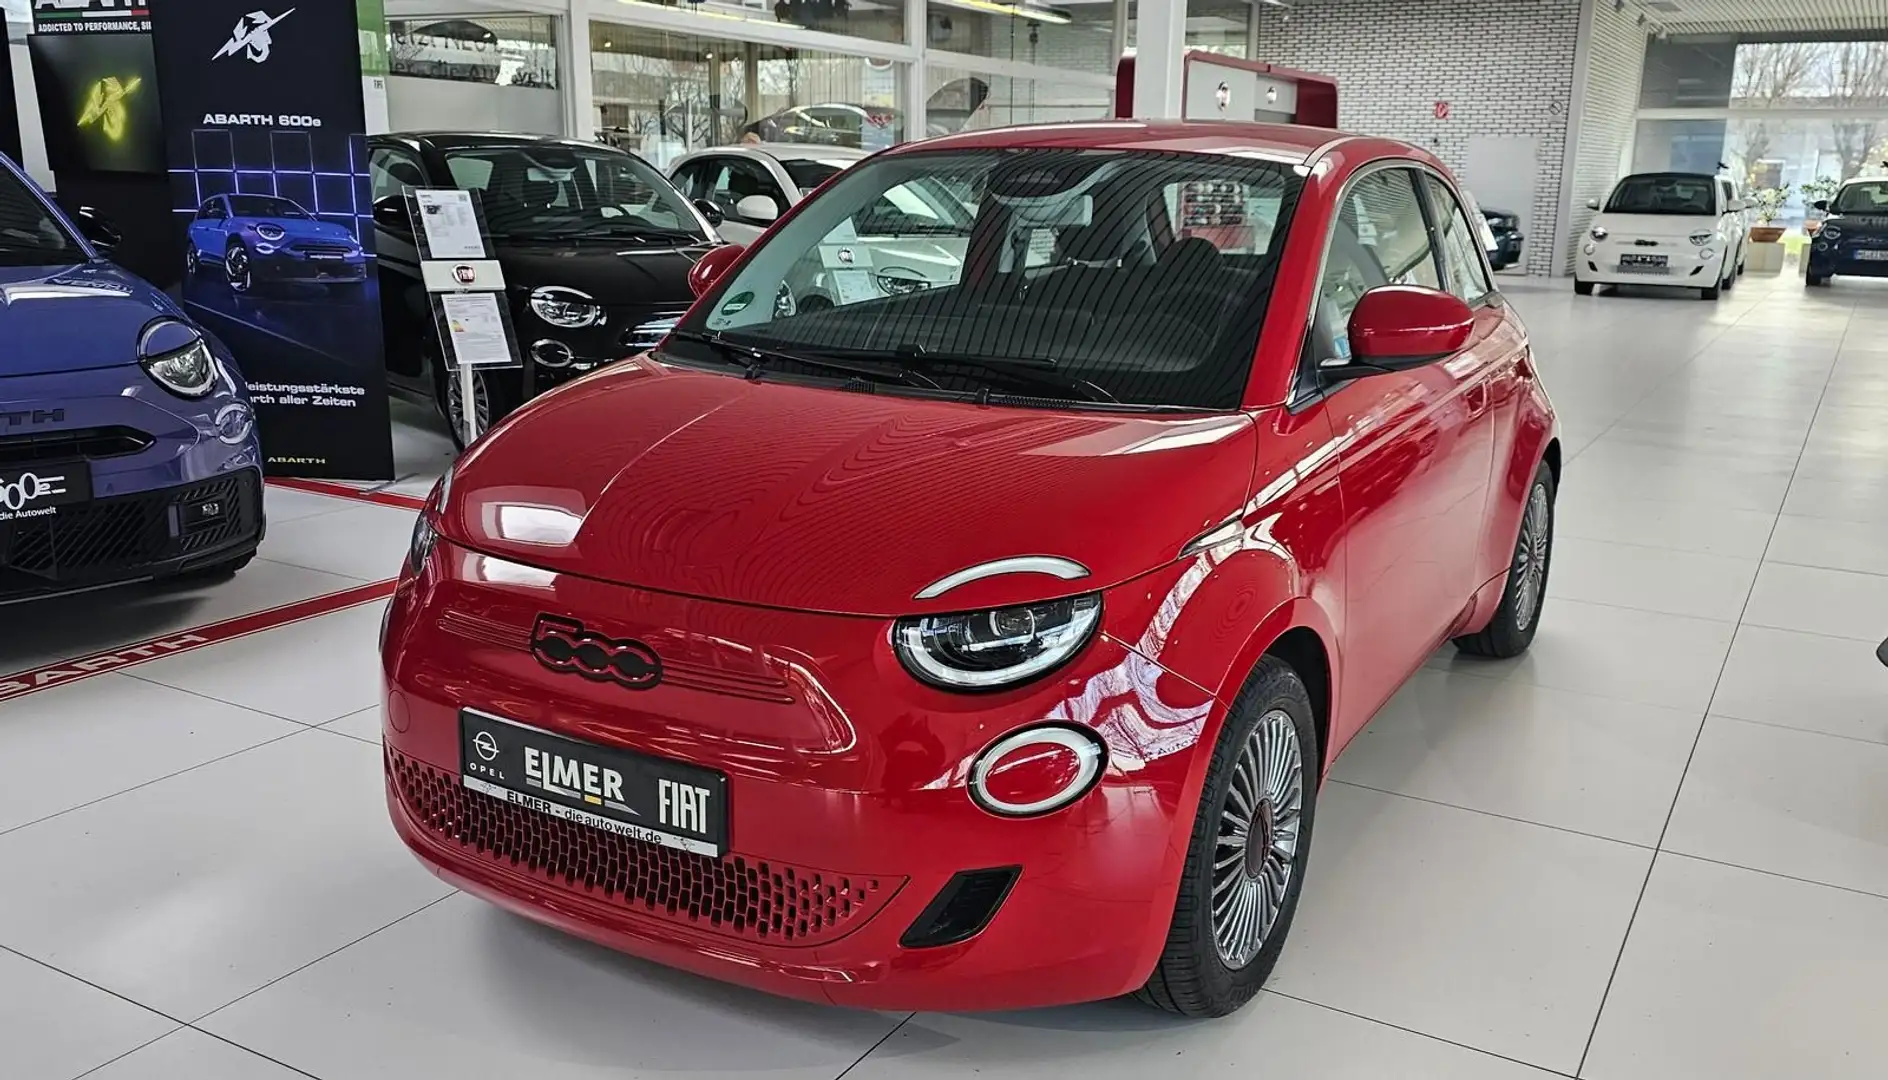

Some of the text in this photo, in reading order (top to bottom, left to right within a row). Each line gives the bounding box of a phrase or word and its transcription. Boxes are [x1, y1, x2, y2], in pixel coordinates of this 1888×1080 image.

[38, 22, 72, 32] ADDICTED
[73, 22, 84, 31] TO
[85, 21, 140, 32] PERFORMANCE,
[203, 113, 321, 127] ABARTH 600e
[250, 395, 356, 407] rth aller Zeiten
[267, 456, 326, 464] ABARTH
[15, 505, 57, 518] Autowelt
[529, 611, 663, 691] 500
[469, 761, 505, 780] OPEL
[524, 746, 626, 803] ELMER
[506, 790, 552, 813] ELMER
[658, 778, 711, 834] FIAT
